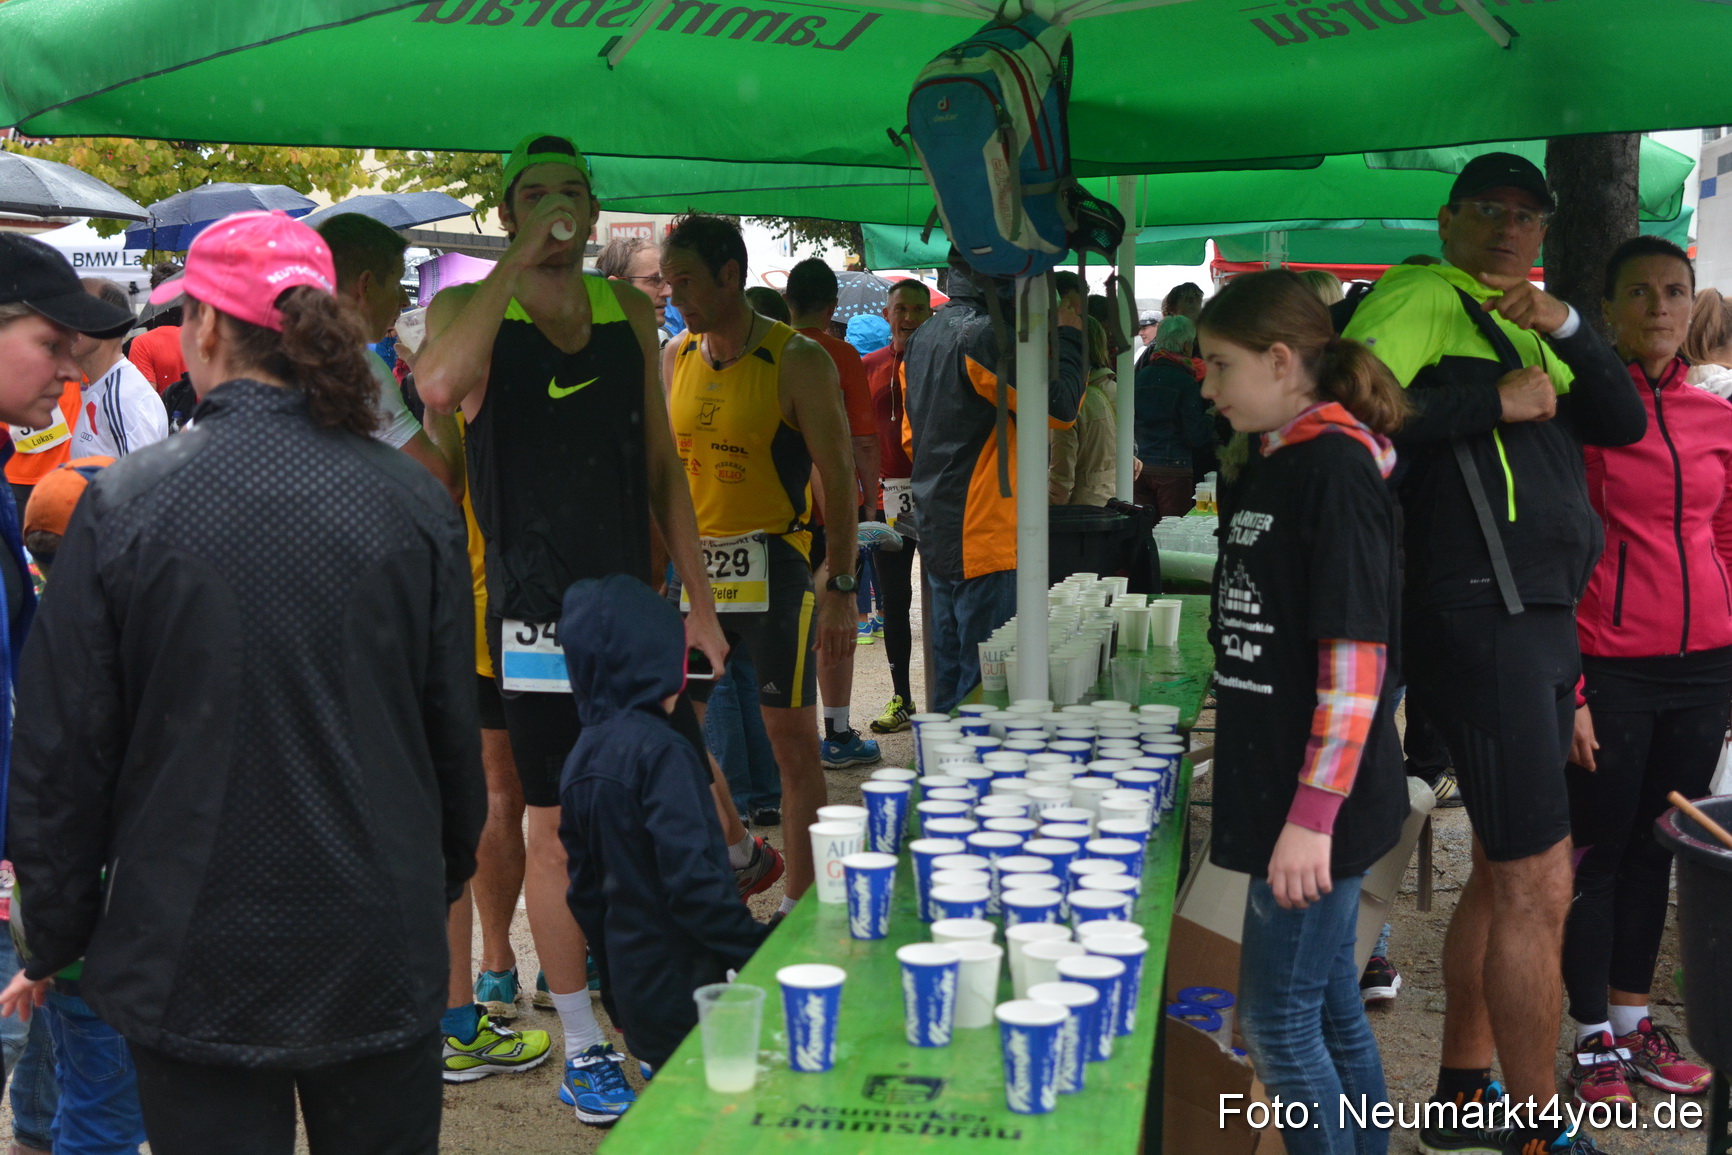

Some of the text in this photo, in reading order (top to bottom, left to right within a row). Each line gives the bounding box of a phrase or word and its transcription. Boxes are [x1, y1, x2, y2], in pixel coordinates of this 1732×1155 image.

[611, 226, 652, 240] NKD
[73, 252, 118, 267] BMW
[31, 433, 54, 447] Lukas
[718, 469, 743, 480] ELIO
[711, 587, 738, 600] Peter
[796, 1104, 988, 1122] Neumarkter
[750, 1112, 1022, 1140] Lammsbräu
